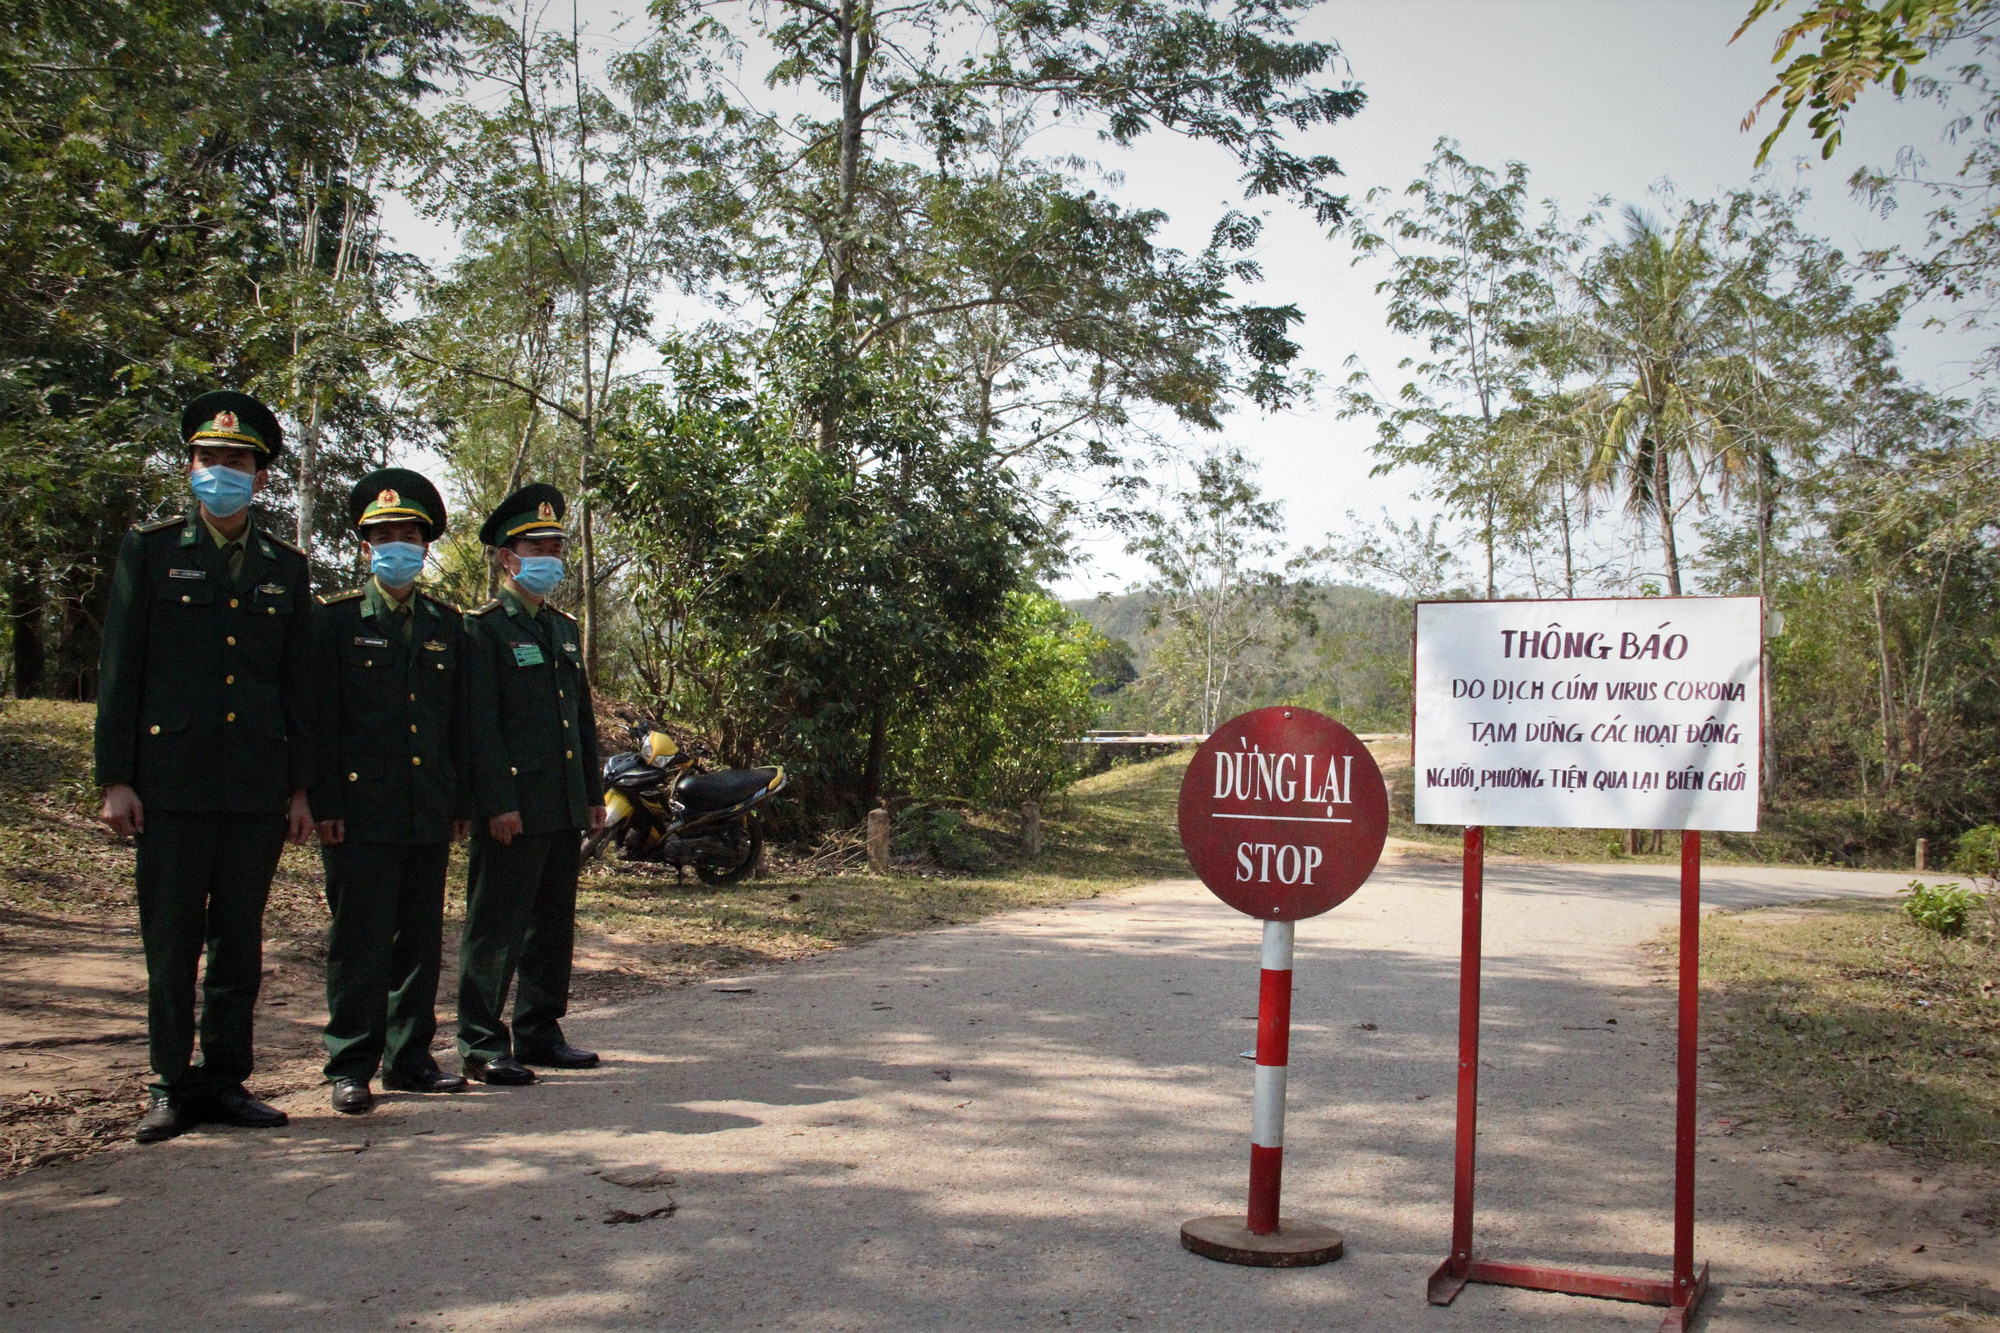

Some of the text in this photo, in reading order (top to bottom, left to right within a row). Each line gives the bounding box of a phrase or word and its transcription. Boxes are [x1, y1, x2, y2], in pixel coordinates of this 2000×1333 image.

[1501, 621, 1688, 660] THÔNG BÁO
[1452, 673, 1745, 704] DO DỊCH CÚM VIRUS CORONA
[1468, 714, 1743, 747] TẠM DỪNG CÁC HOẠT ĐỘNG
[1213, 736, 1353, 818] DỪNG LẠI
[1549, 764, 1588, 793] TIỆN
[1592, 770, 1628, 791] QUA
[1632, 770, 1659, 793] LẠI
[1666, 765, 1704, 791] BIÊN
[1707, 763, 1747, 791] GIỚI
[1236, 842, 1323, 885] STOP
